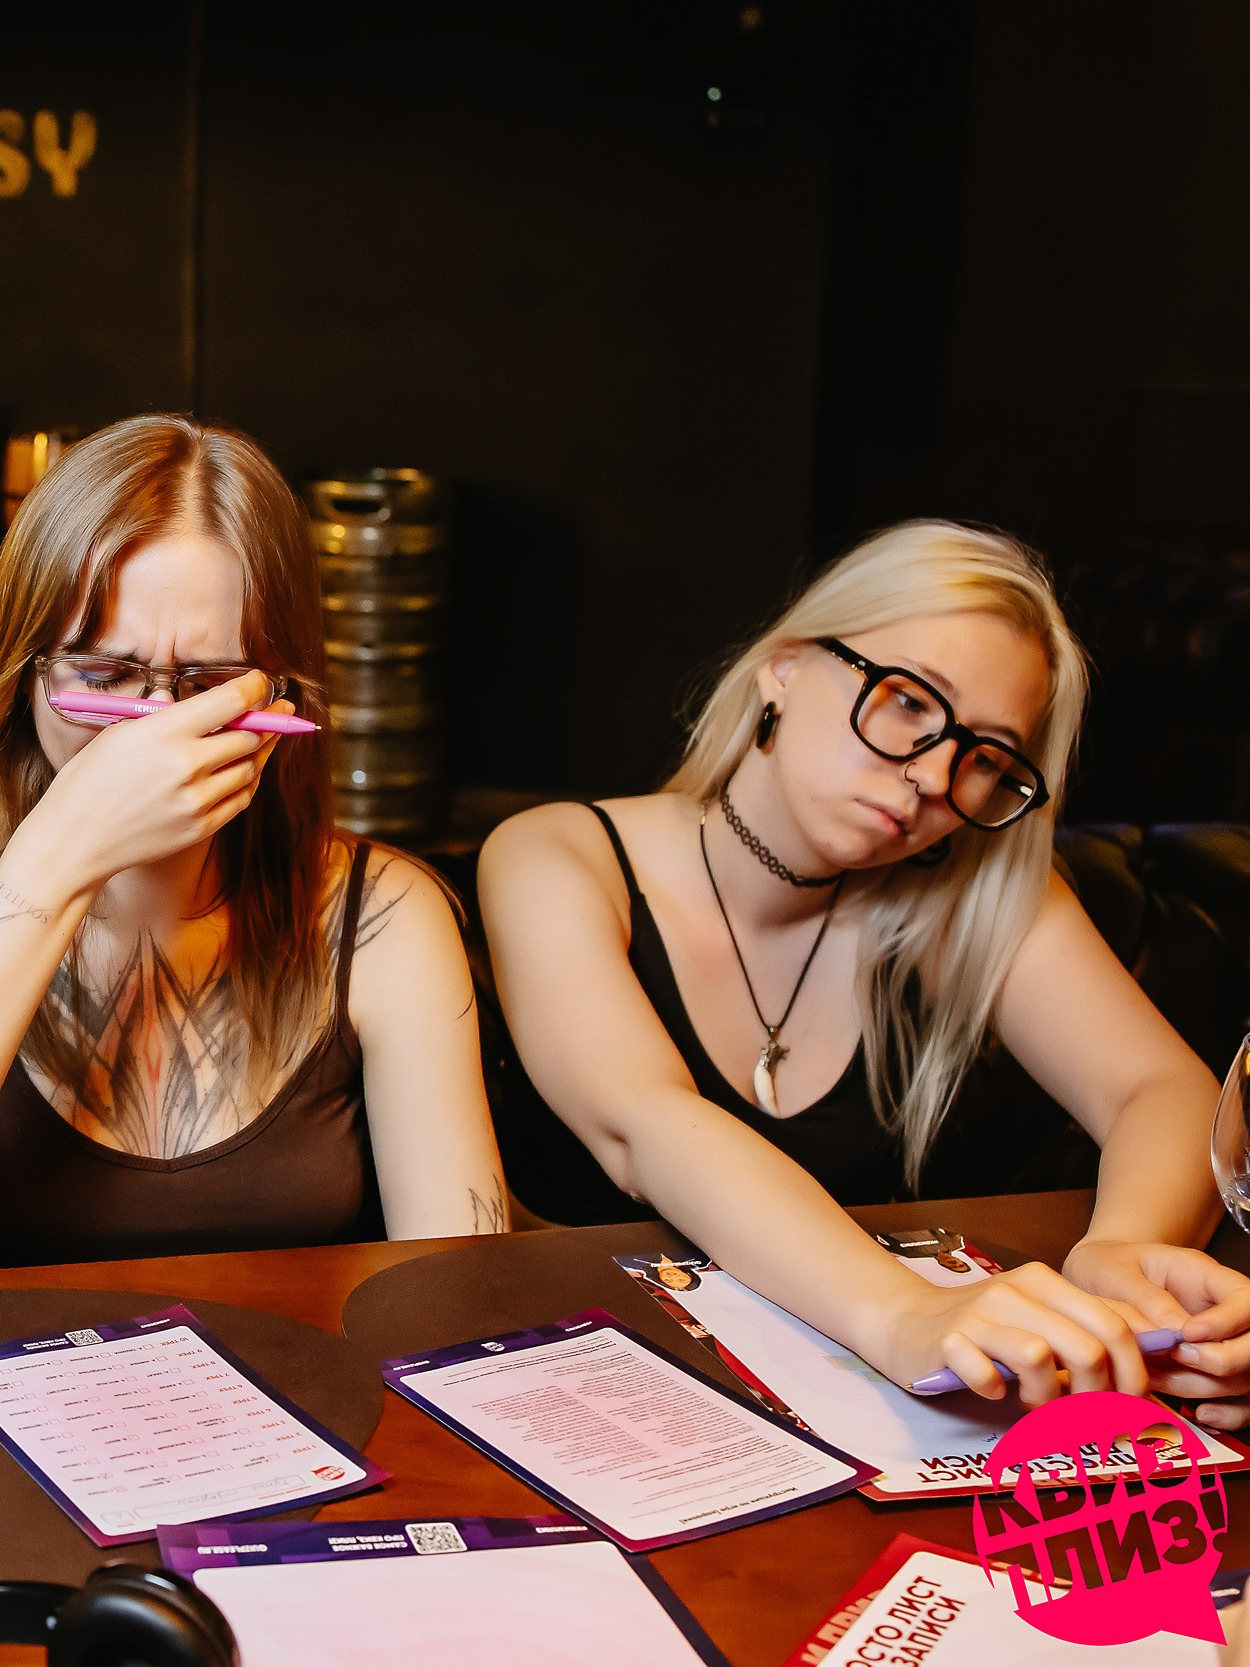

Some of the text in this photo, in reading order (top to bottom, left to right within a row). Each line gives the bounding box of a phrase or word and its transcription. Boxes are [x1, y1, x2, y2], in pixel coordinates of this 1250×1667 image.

[916, 1467, 992, 1483] ИСТ
[887, 1575, 942, 1625] ЛИСТ
[891, 1595, 966, 1667] ЗАПИСИ
